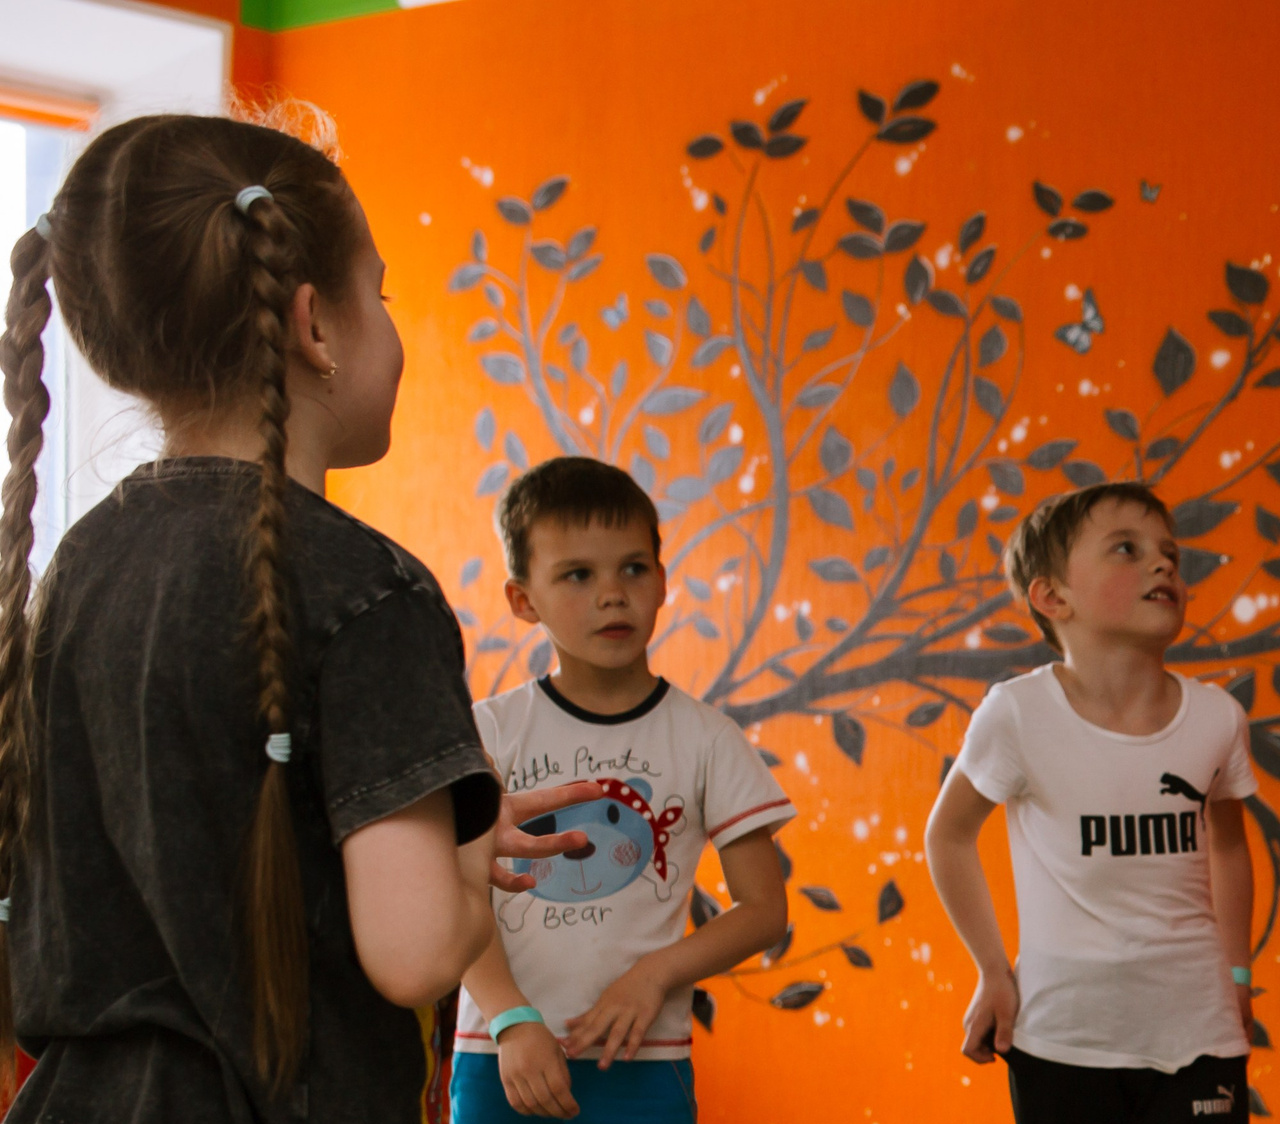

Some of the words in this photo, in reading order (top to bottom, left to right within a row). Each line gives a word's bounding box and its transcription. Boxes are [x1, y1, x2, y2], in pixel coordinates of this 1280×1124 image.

[505, 752, 564, 793] ittle
[574, 746, 662, 777] Pirate
[1080, 811, 1197, 856] PUMA
[543, 905, 612, 929] Bear
[1192, 1099, 1231, 1116] PUMA
